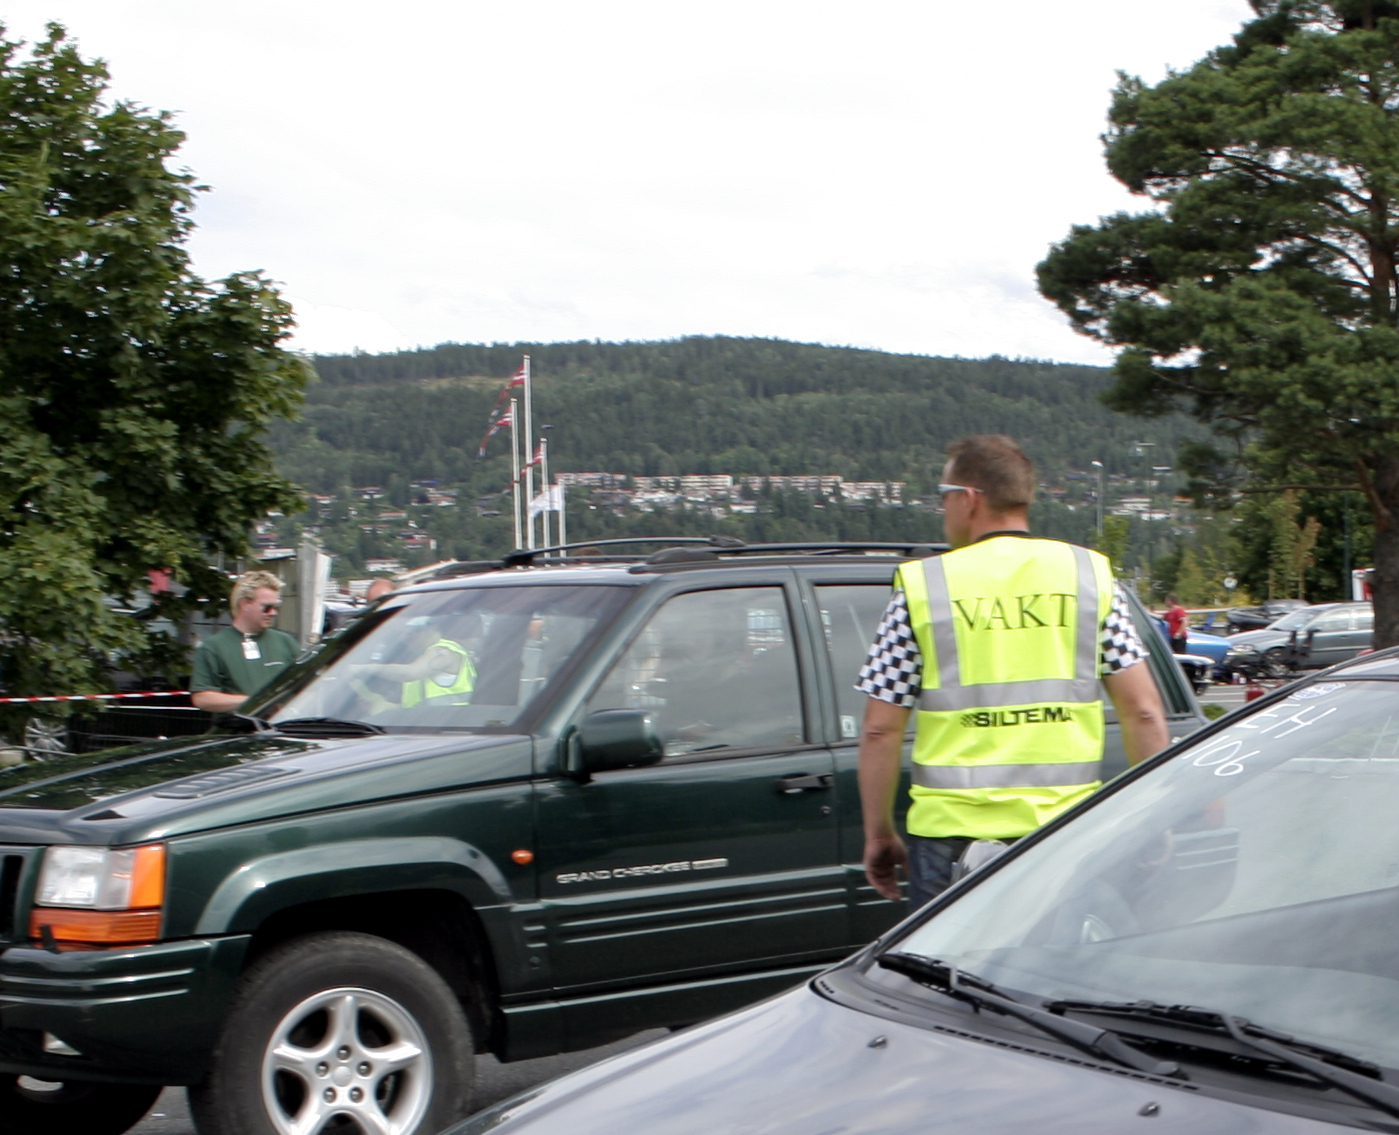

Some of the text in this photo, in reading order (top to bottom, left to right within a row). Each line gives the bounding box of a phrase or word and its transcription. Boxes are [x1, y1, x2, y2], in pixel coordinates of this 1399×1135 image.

[953, 593, 1077, 632] VAKT
[1181, 734, 1261, 777] 106
[556, 869, 612, 884] GRAND
[612, 861, 691, 878] CHEROKEE
